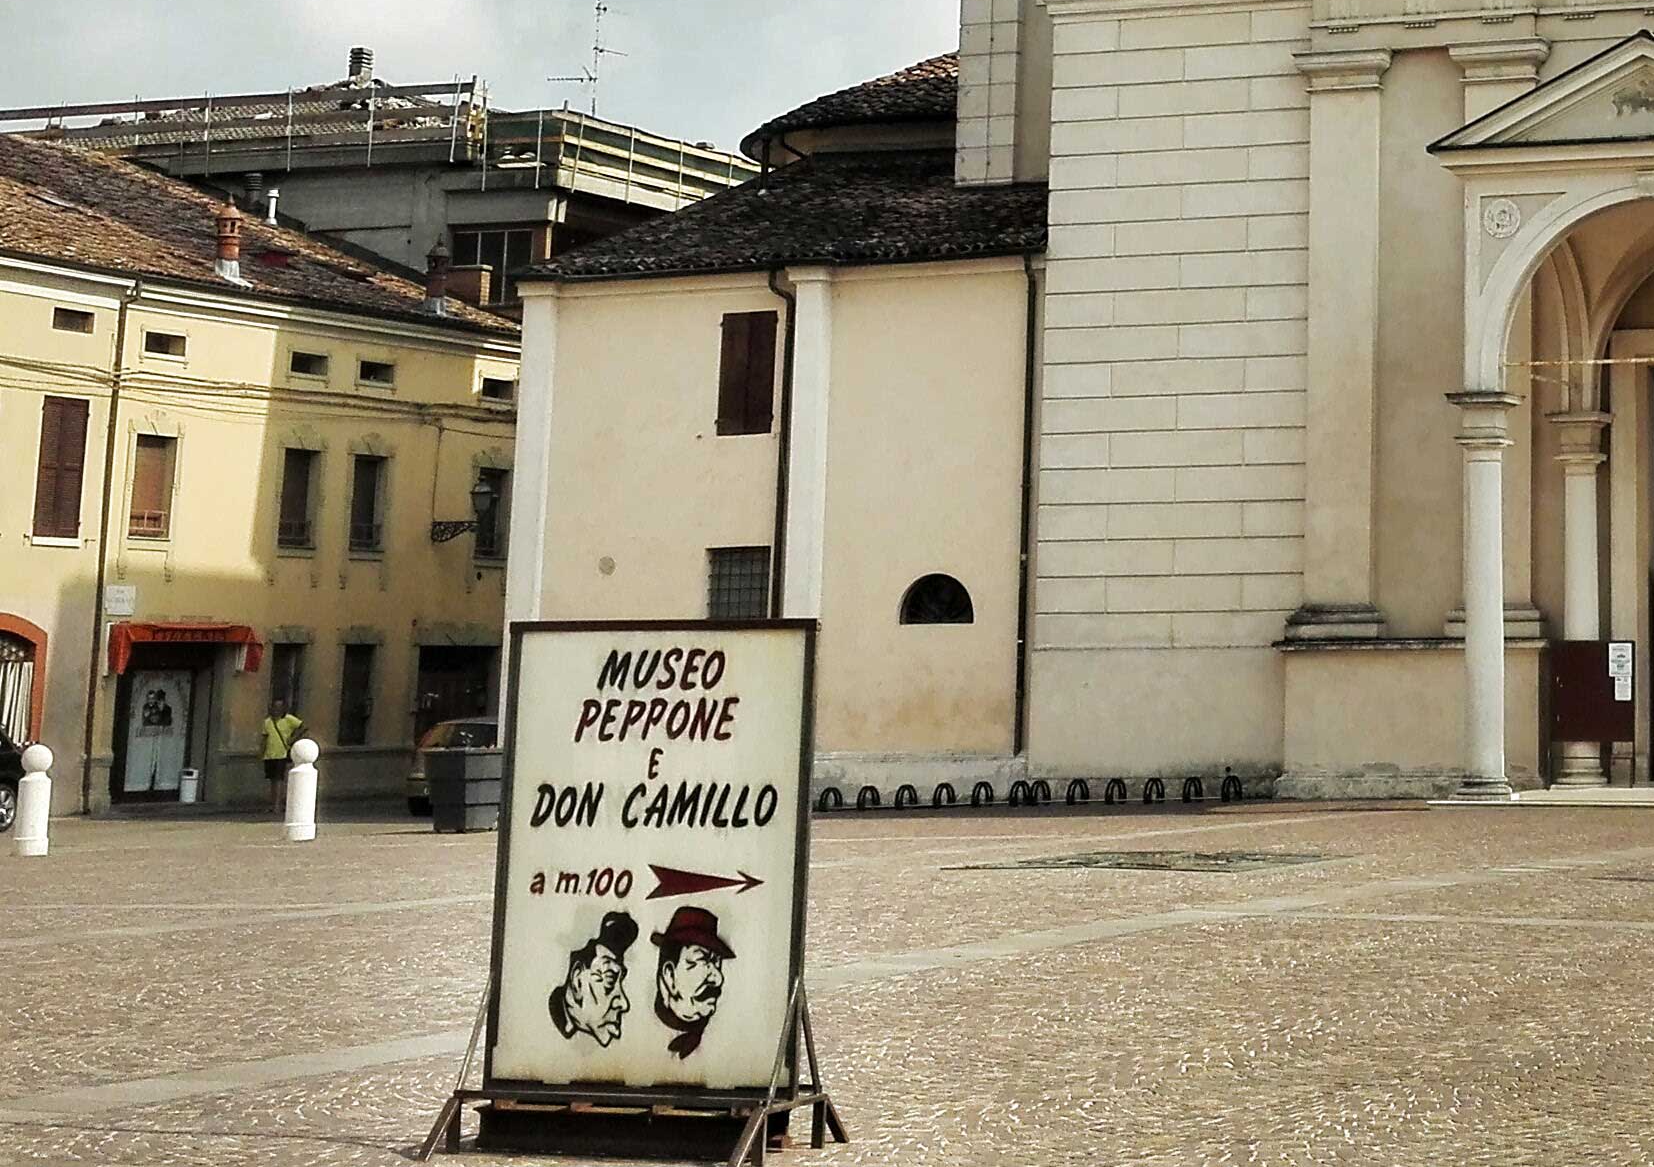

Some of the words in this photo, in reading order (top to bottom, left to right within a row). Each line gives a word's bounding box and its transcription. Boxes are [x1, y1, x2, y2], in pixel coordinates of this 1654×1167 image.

[596, 648, 726, 691] MUSEO
[574, 696, 740, 743] PEPPONE
[647, 747, 664, 780] E
[529, 781, 605, 828] DON
[621, 780, 778, 829] CAMILLO
[529, 872, 546, 895] a
